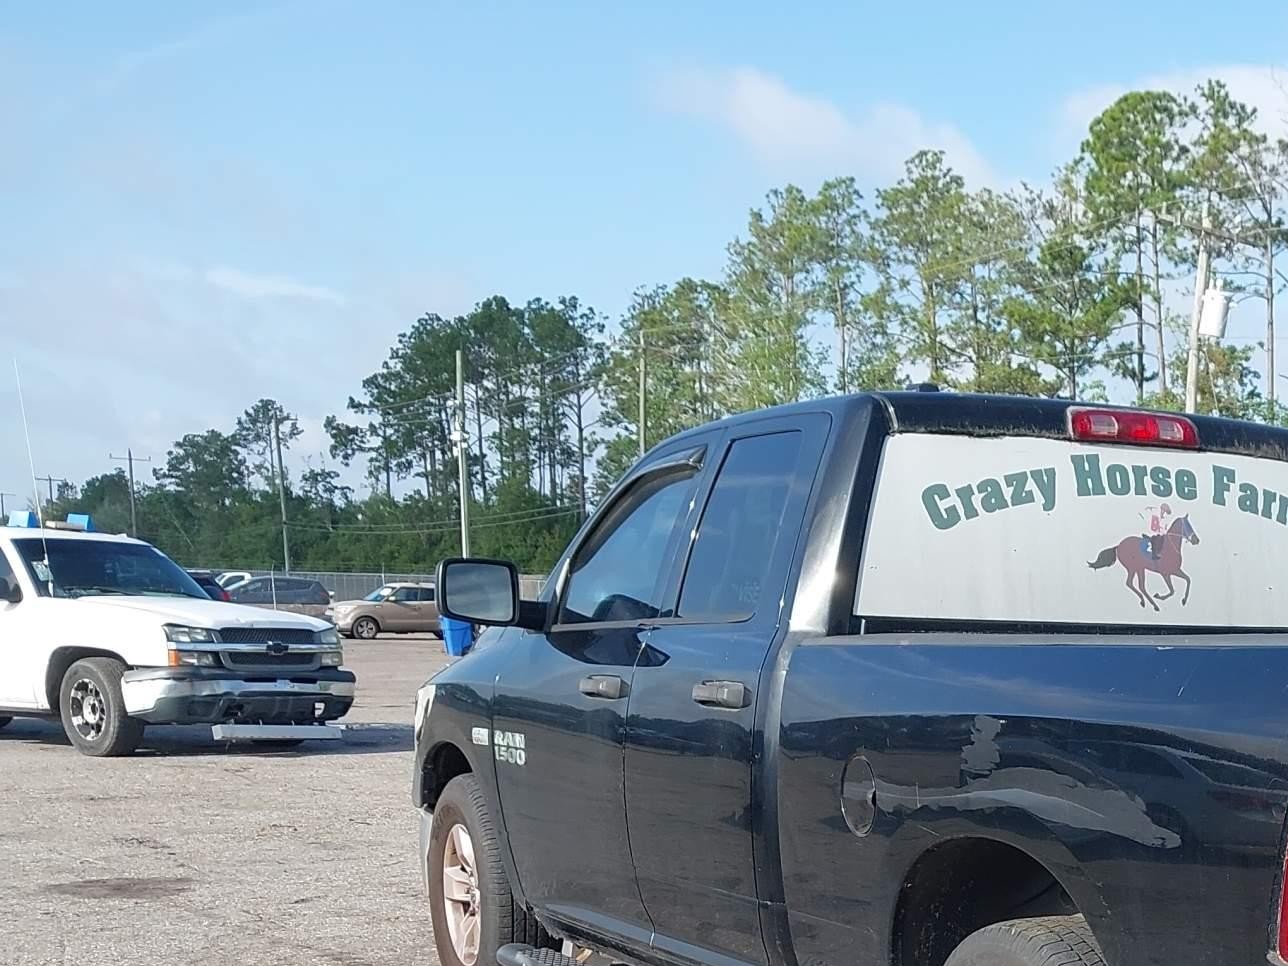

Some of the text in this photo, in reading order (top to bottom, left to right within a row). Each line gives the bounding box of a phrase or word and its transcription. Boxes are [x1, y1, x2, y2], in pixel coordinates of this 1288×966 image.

[921, 467, 1056, 530] Crazy
[1071, 454, 1198, 500] Horse
[494, 745, 526, 766] 1500
